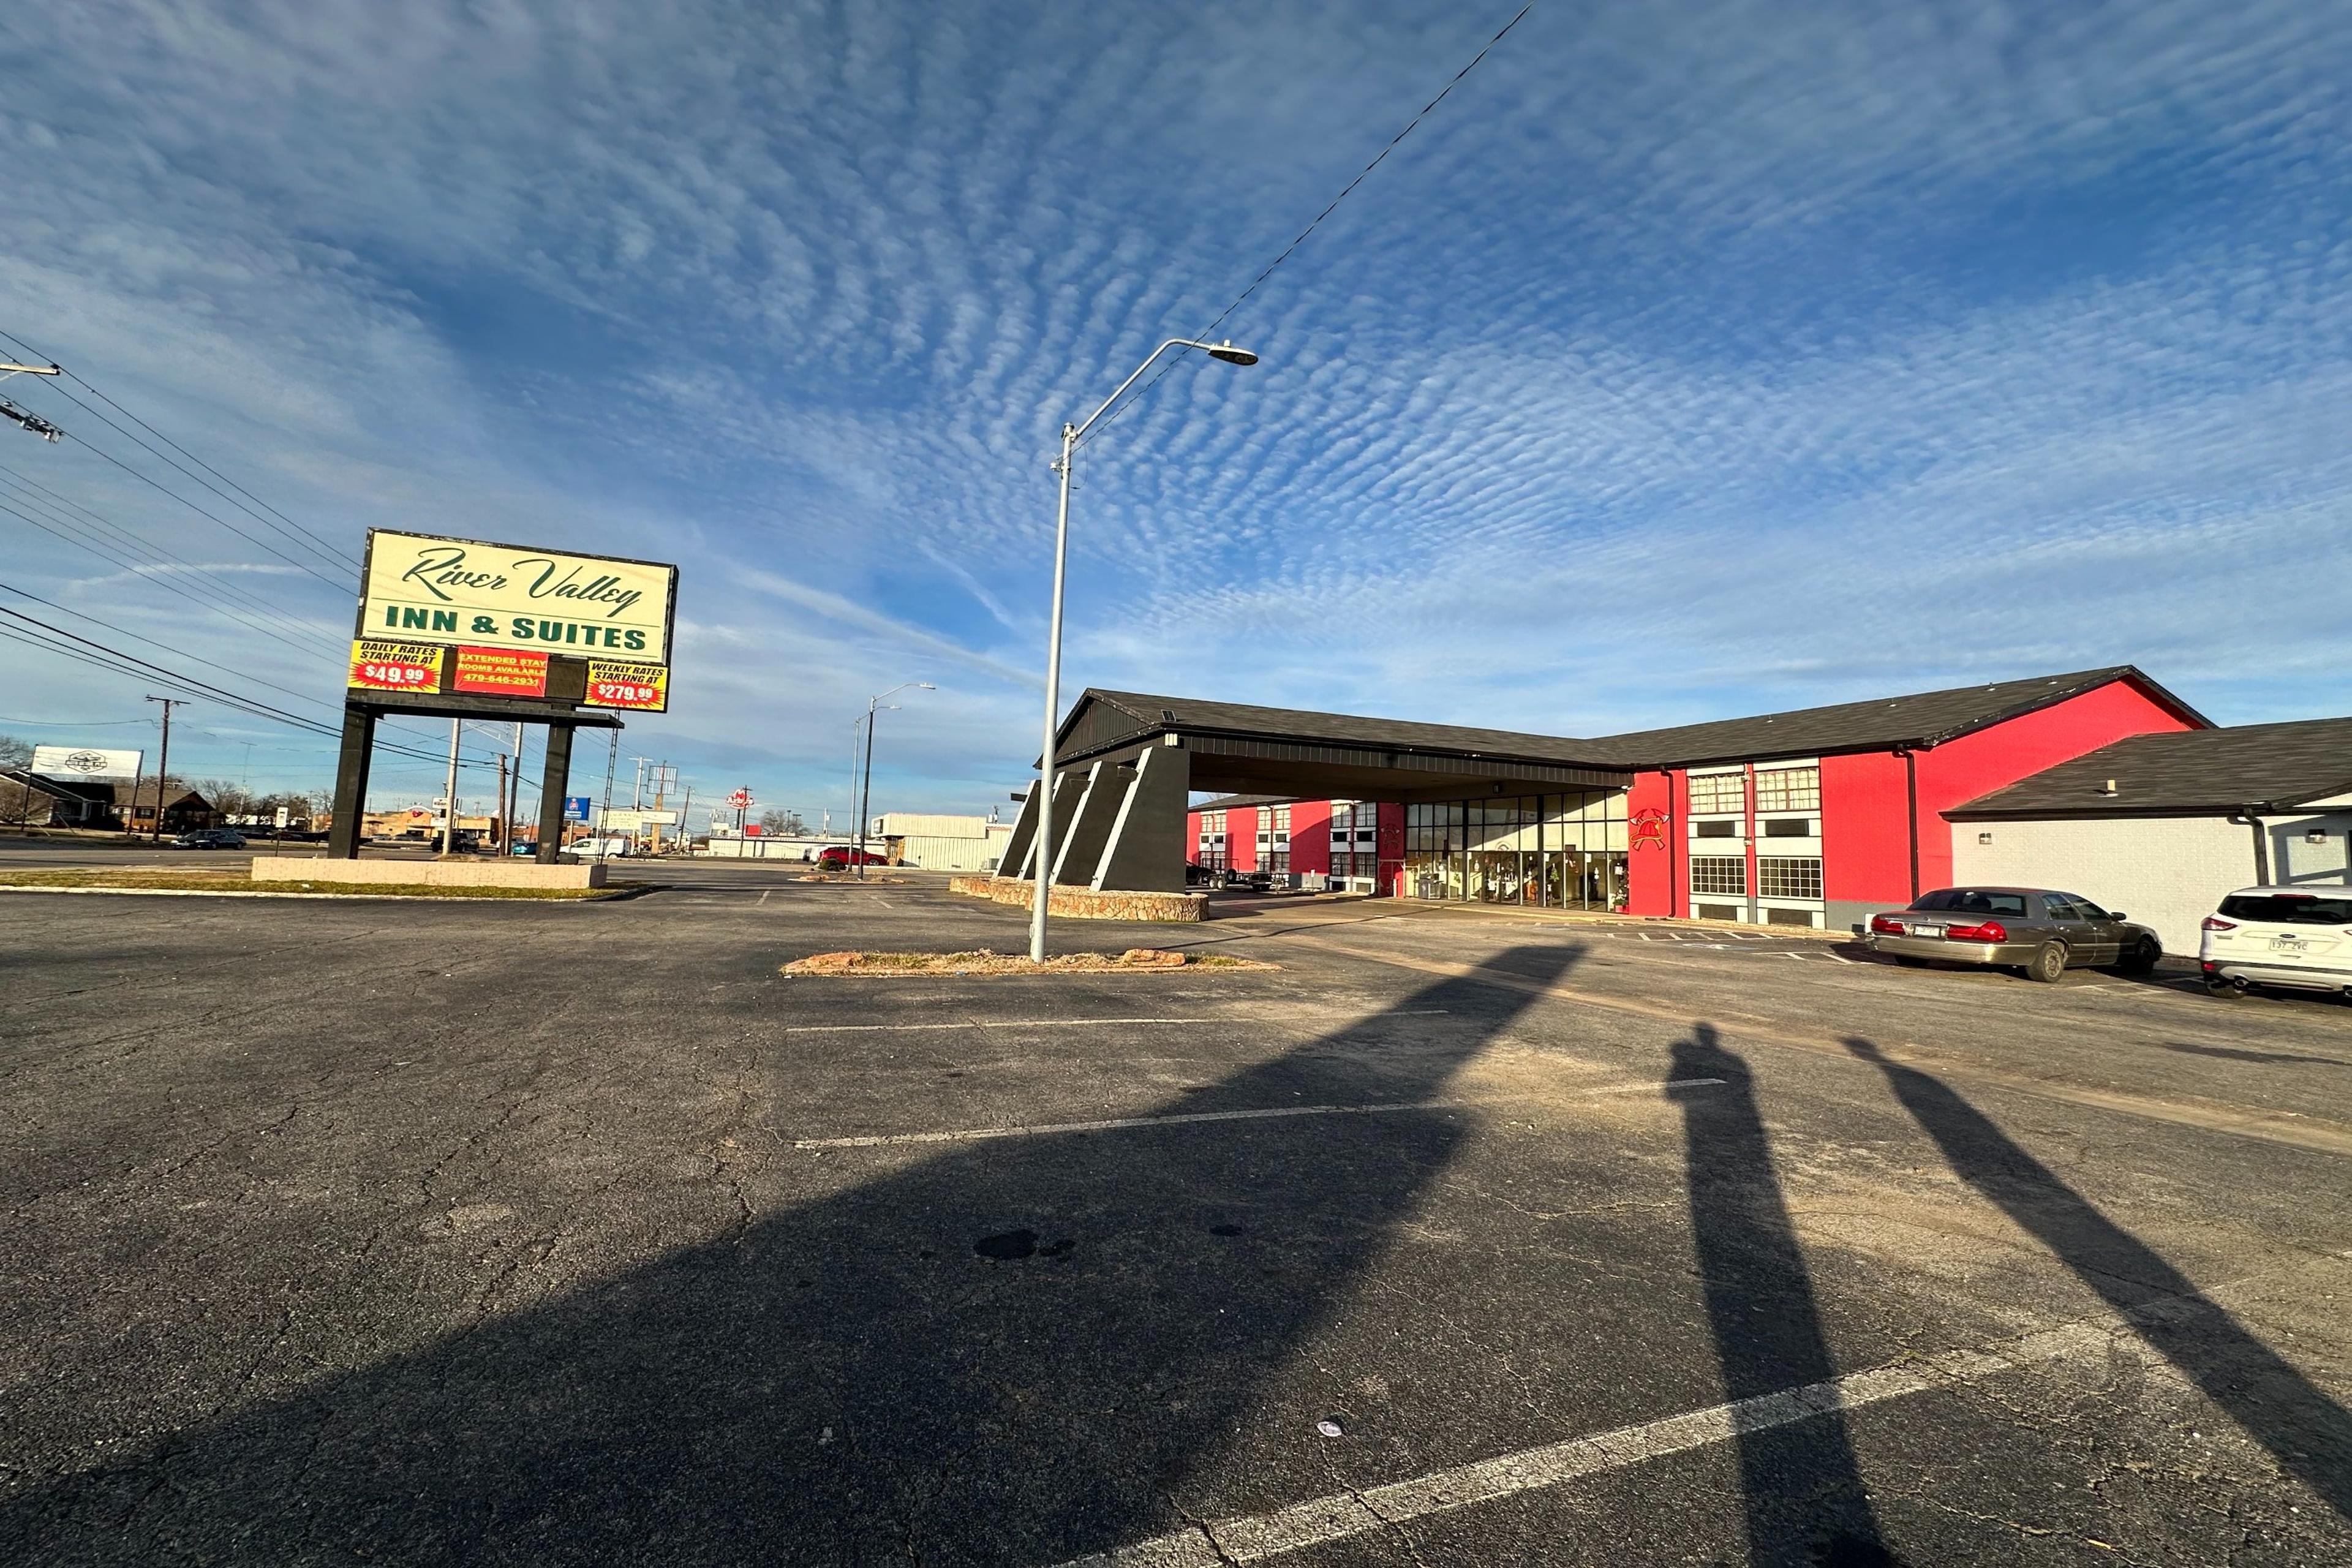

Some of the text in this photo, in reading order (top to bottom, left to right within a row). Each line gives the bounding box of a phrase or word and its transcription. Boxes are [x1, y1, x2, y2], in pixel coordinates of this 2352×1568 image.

[402, 548, 643, 617] River Valley
[385, 606, 646, 650] INN & SUITES
[360, 642, 437, 656] DAILY RATES
[360, 651, 436, 665] STARTING AT
[459, 654, 516, 664] EXTENDED
[365, 665, 424, 684] $49.99
[458, 663, 546, 676] ROOMS AVAILABLE
[592, 663, 664, 676] WEEKLY RATES
[464, 674, 538, 685] 479-646-2931
[594, 671, 645, 683] STARTING
[598, 684, 653, 701] $279.99
